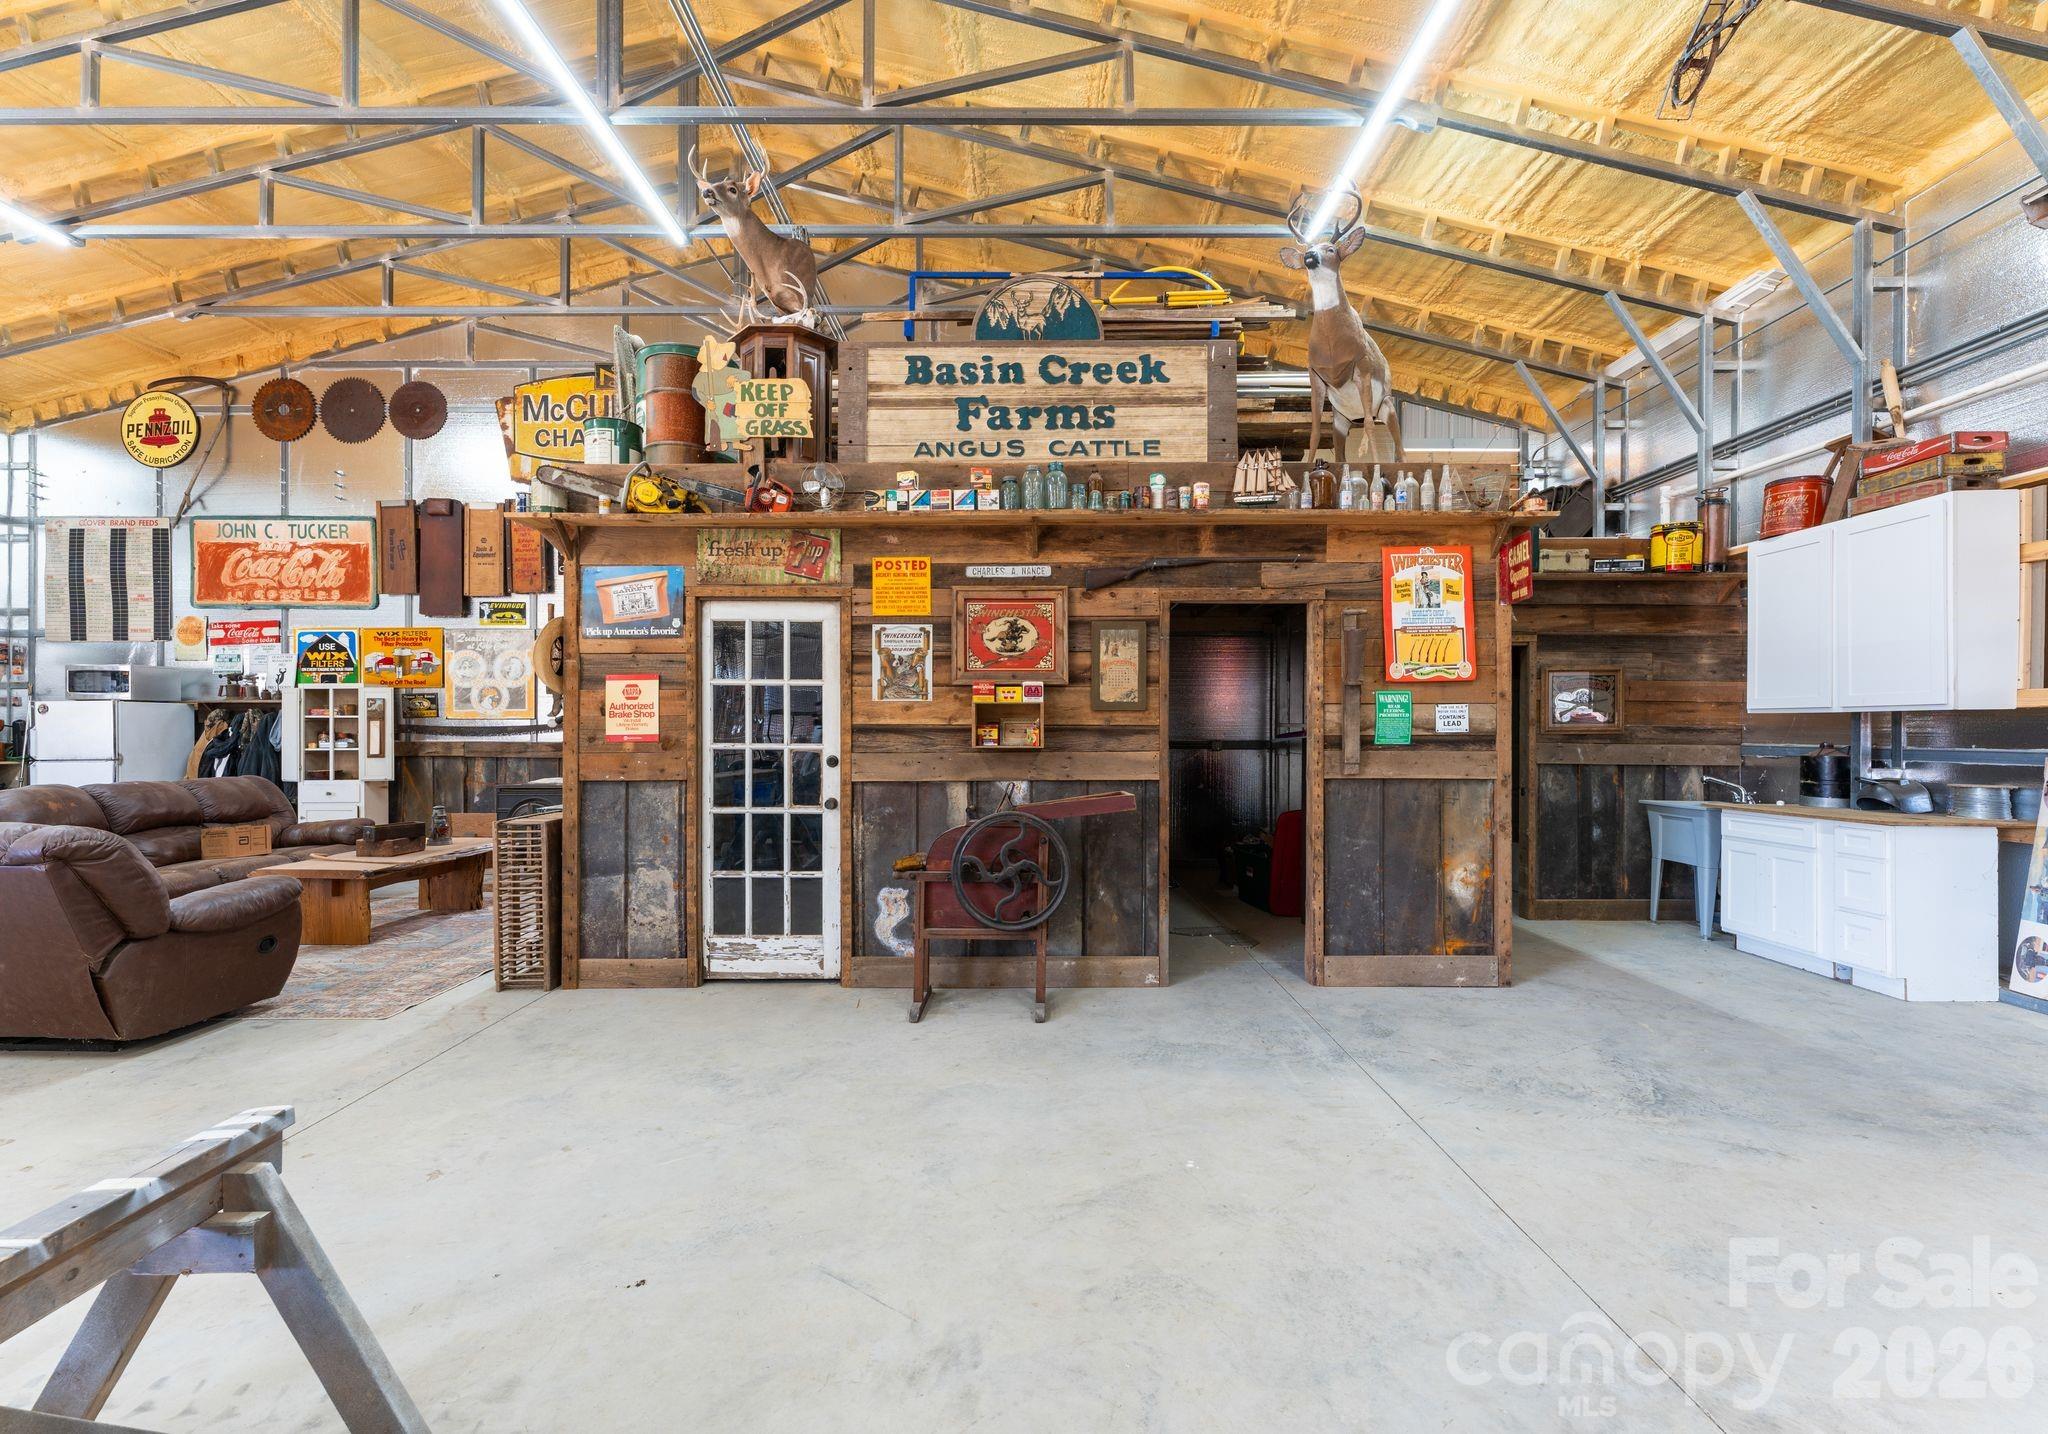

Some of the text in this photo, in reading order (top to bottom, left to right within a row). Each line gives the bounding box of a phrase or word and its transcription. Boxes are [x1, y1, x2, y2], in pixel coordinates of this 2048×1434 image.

[904, 353, 1171, 386] Basin Creek
[740, 381, 793, 402] KEEP
[143, 394, 174, 404] Pennsylvania
[754, 402, 789, 418] OFF
[954, 394, 1116, 432] Farms
[126, 420, 193, 438] PENNZOIL
[745, 418, 808, 437] GRASS
[534, 428, 585, 447] CHA
[127, 439, 192, 465] SAFE LUBRICATION
[913, 439, 1161, 458] ANGUS CATTLE
[1862, 463, 1934, 492] PEPSI
[1852, 481, 1946, 508] PEPSI
[79, 519, 106, 527] CLOVER
[216, 523, 349, 539] JOHN C. TUCKER
[221, 548, 350, 588] Coca-Cola
[875, 560, 928, 571] POSTED
[972, 567, 1005, 576] CHARLES
[1021, 567, 1046, 576] NANCE
[1391, 555, 1464, 574] WINCHESTER
[978, 608, 1046, 617] WINCHESTER
[227, 627, 260, 638] Coca-Cola
[586, 626, 679, 638] Pick up America's favorite.
[318, 643, 336, 651] USE
[306, 652, 348, 661] WIX
[310, 660, 345, 668] FILTERS
[623, 688, 641, 696] NAPA
[1378, 694, 1409, 703] WARNING!
[609, 702, 655, 711] Authorized
[608, 710, 655, 720] Brake Shop
